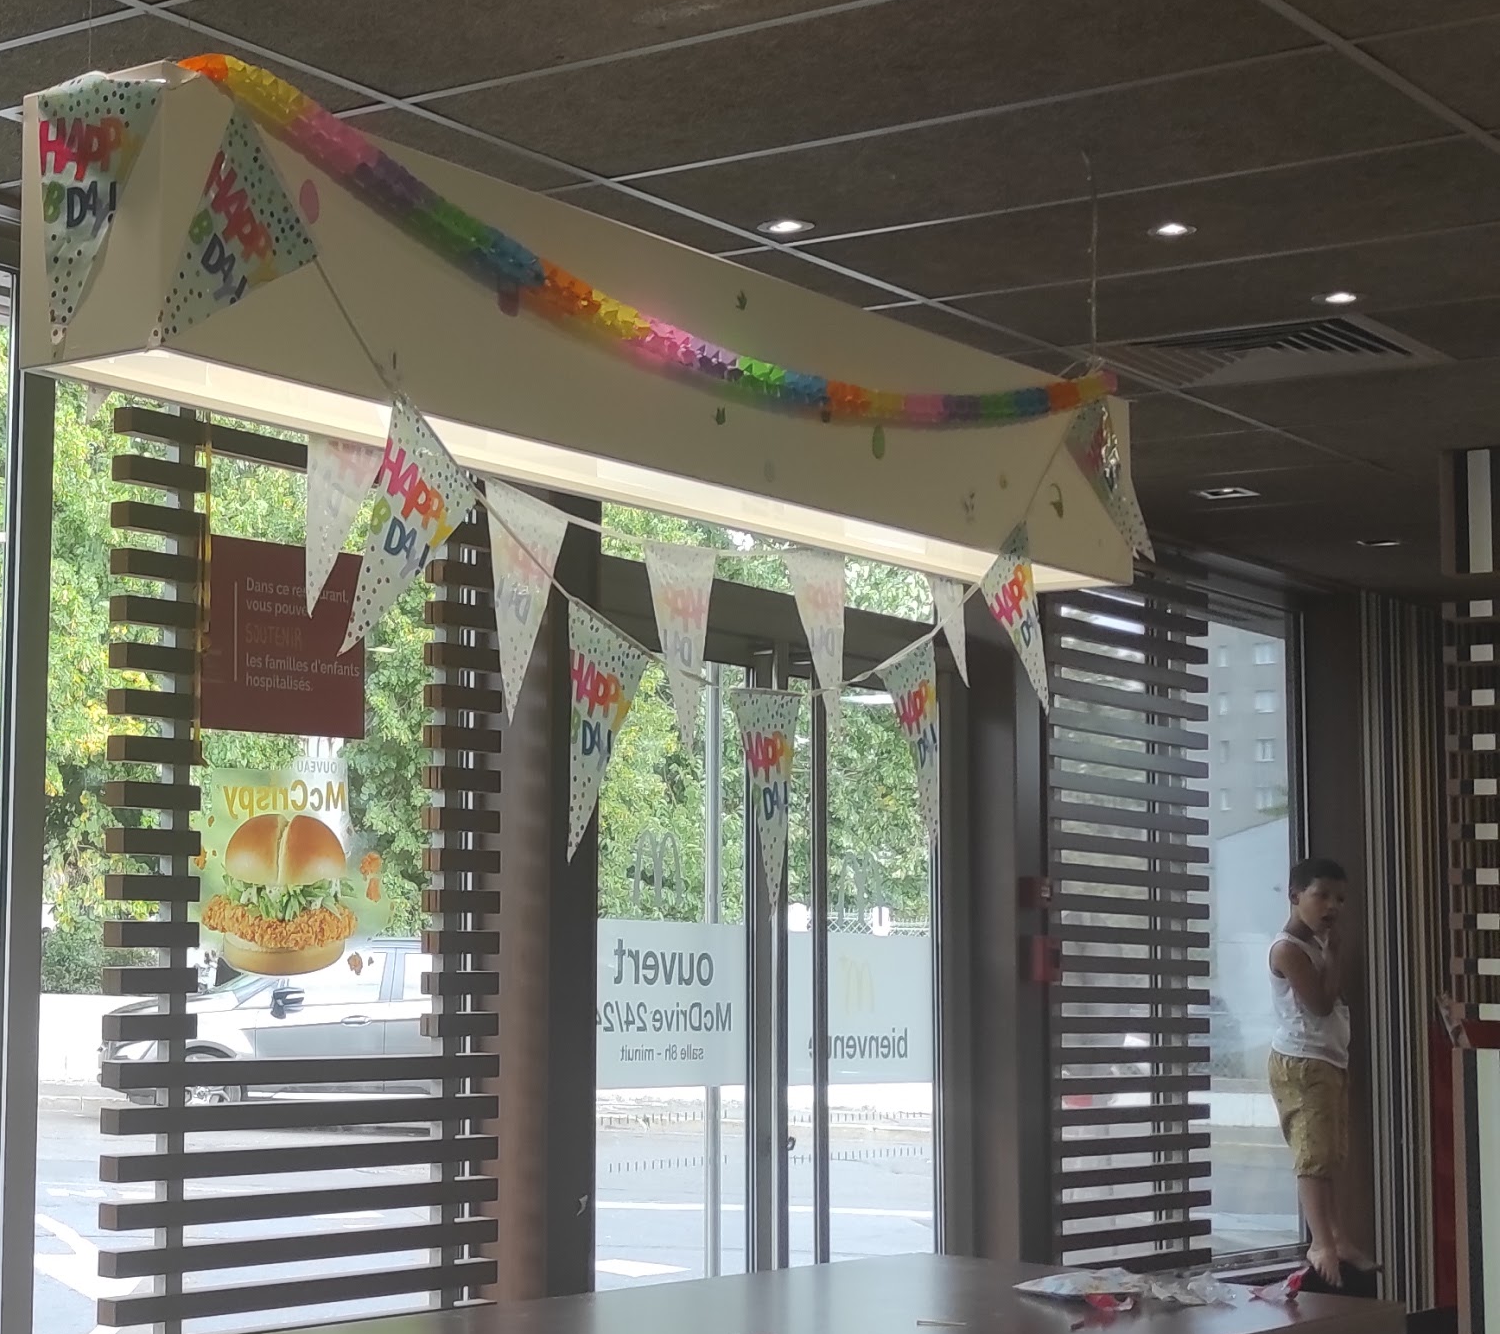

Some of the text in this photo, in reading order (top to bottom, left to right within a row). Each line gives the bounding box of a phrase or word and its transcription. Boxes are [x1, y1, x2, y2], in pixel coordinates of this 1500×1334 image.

[39, 116, 144, 183] HAPPY
[376, 436, 454, 549] HAPPY
[246, 577, 274, 595] Dans
[276, 584, 290, 596] ce
[246, 598, 309, 617] vous pouve
[245, 622, 302, 648] SOUTENIR
[246, 652, 361, 678] les familles d'enfants
[246, 672, 315, 692] hospitalisés.
[570, 649, 631, 732] HAPPY
[741, 730, 794, 783] HAPPY
